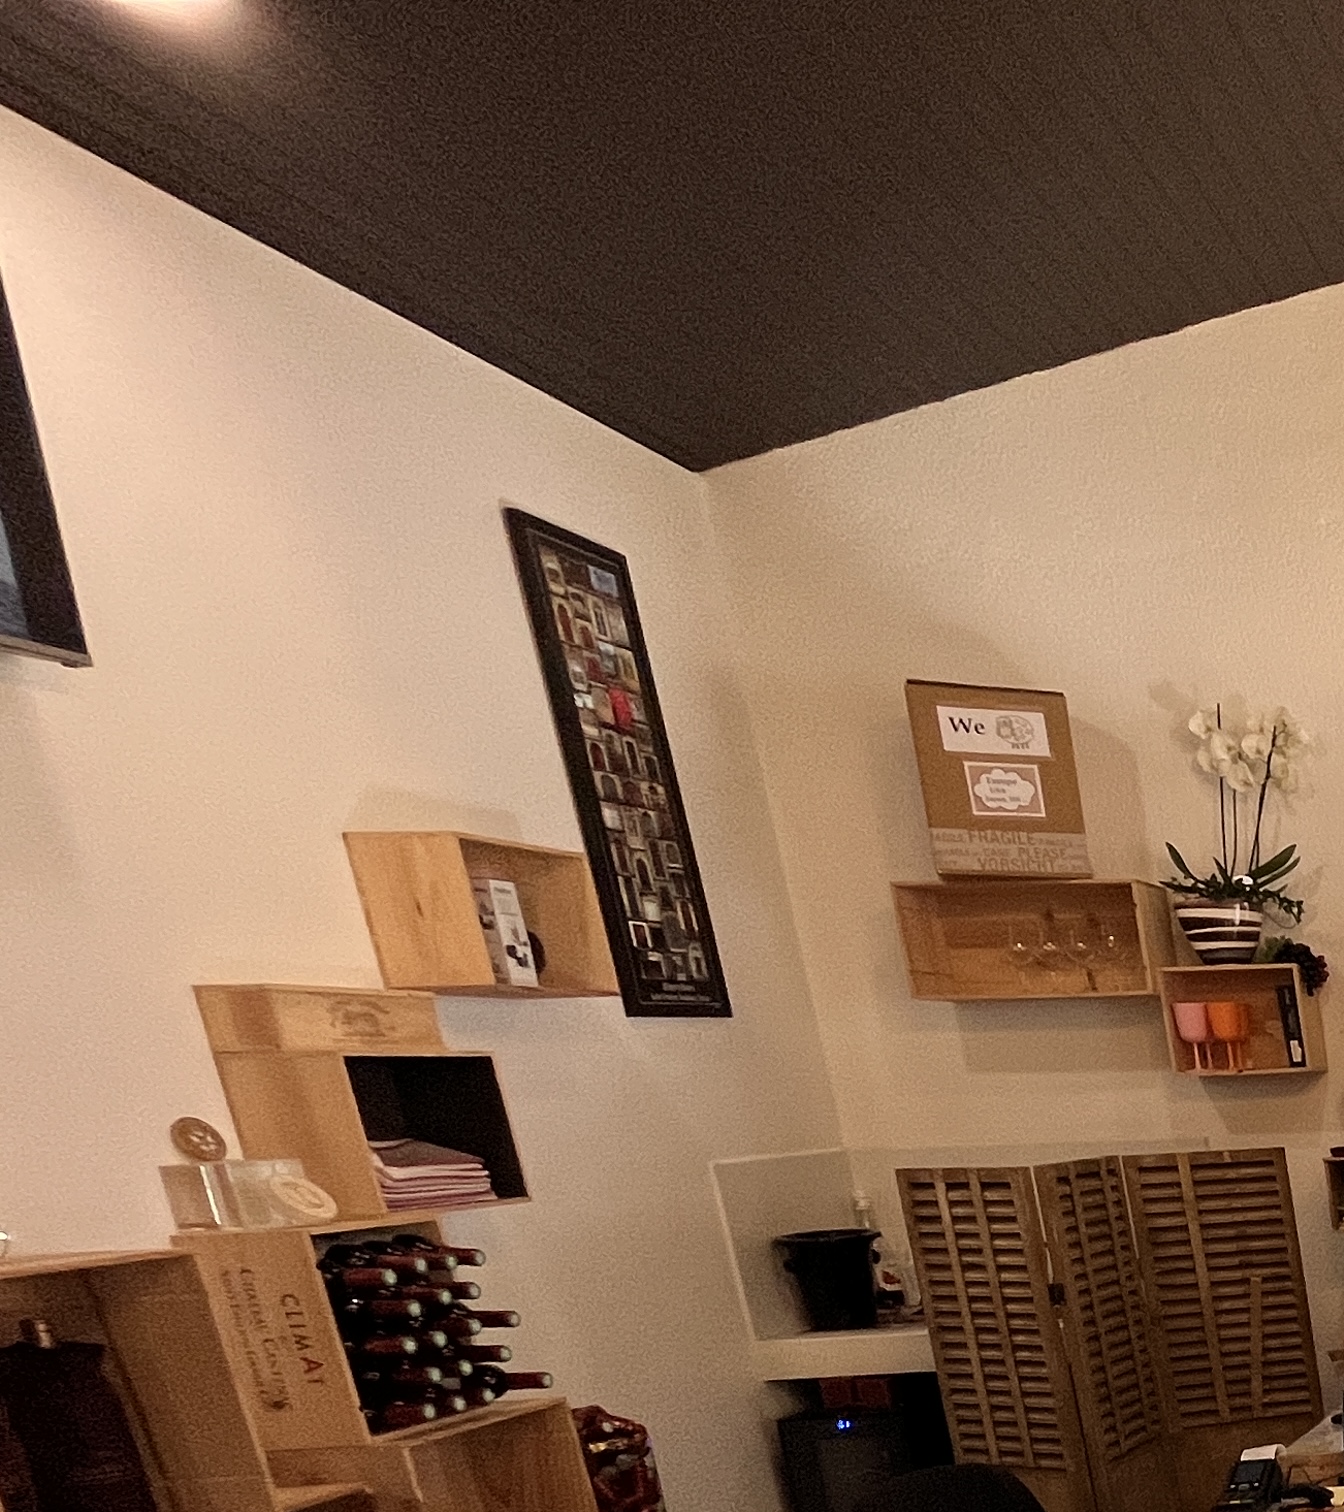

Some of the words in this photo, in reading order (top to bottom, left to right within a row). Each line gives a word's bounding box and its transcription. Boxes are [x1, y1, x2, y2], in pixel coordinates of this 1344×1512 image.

[948, 716, 986, 735] We
[968, 830, 1035, 845] FRAGILE
[1018, 846, 1067, 859] PLEASE
[978, 857, 1056, 873] VORSICHT
[281, 1294, 325, 1385] CLIMAT
